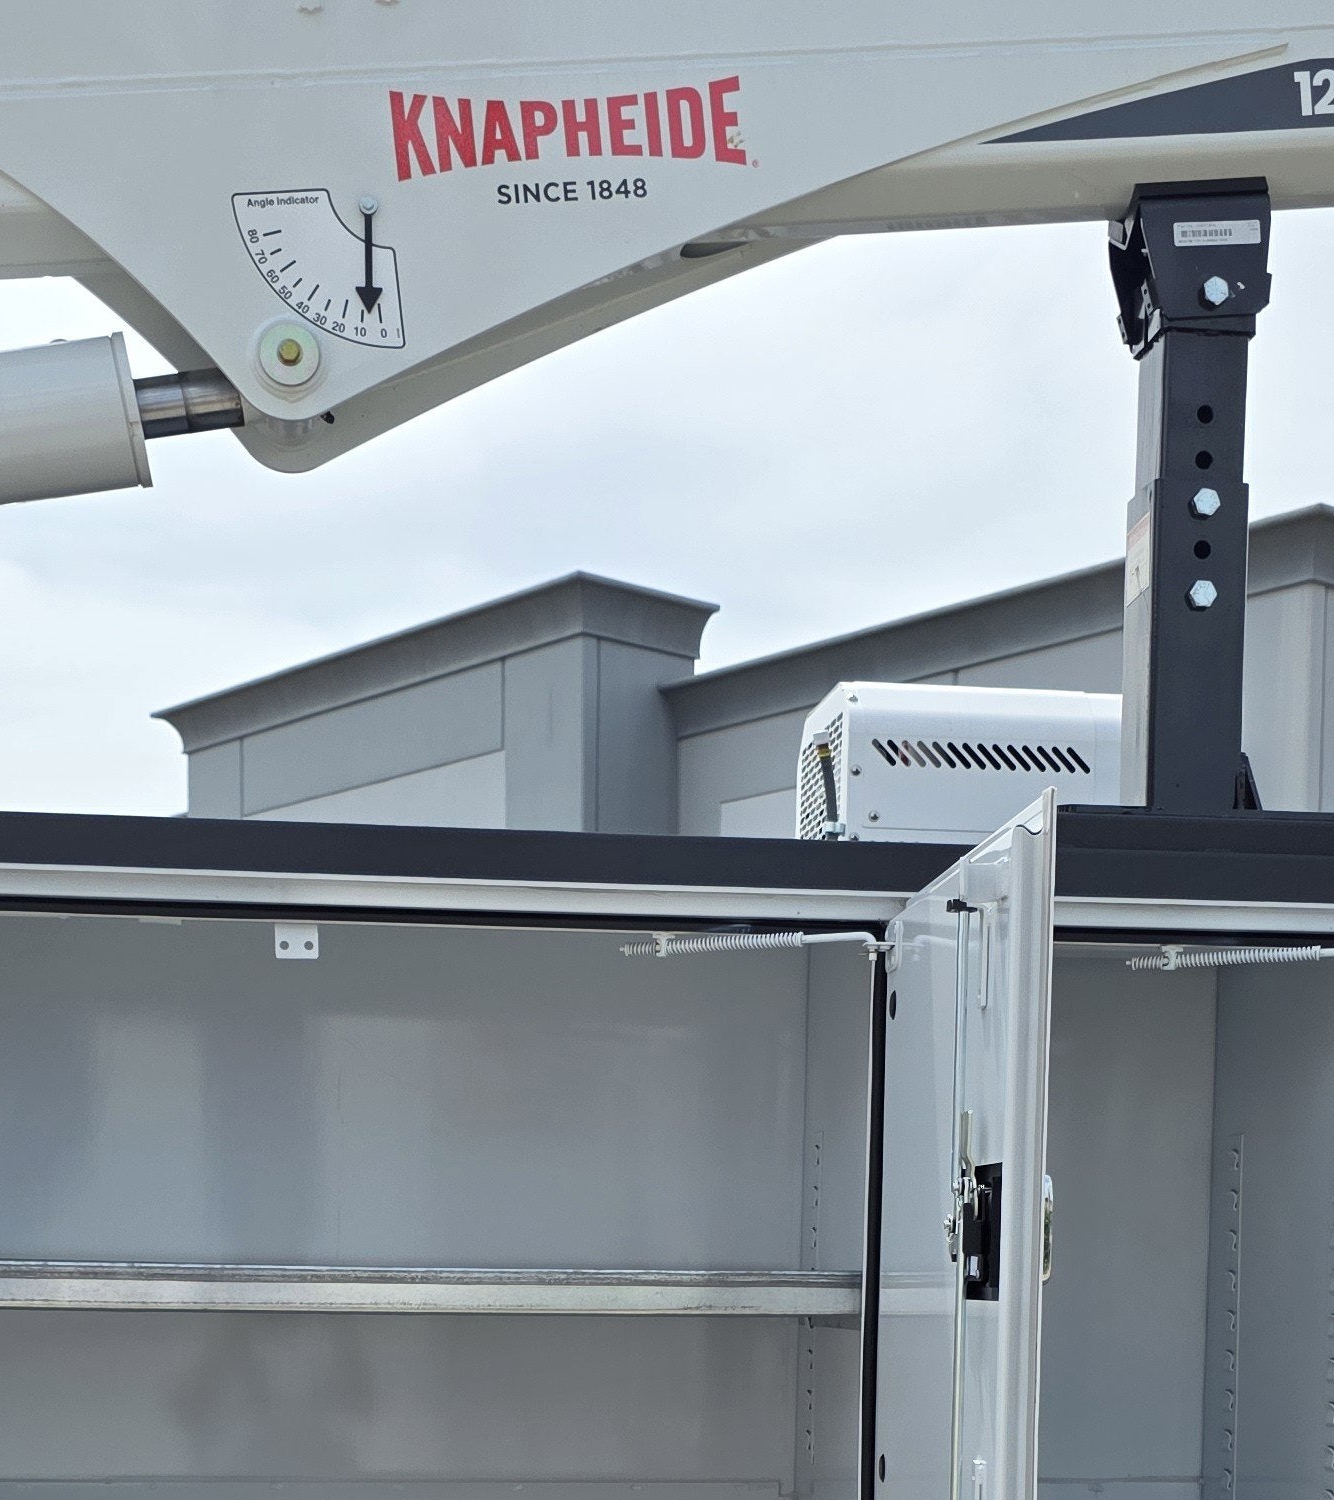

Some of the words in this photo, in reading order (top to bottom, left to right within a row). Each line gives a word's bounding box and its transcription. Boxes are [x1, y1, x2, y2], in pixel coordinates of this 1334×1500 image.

[388, 75, 748, 182] KNAPHEIDE
[496, 181, 579, 205] SINCE
[585, 178, 648, 201] 1848
[246, 198, 275, 209] Angle
[276, 196, 320, 206] Indicator
[247, 228, 260, 244] 80
[254, 249, 268, 265] 70
[266, 269, 280, 284] 60
[278, 286, 293, 300] 50
[295, 301, 309, 314] 40
[312, 312, 328, 326] 30
[331, 321, 346, 333] 20
[353, 326, 367, 337] 10
[380, 328, 388, 338] 0
